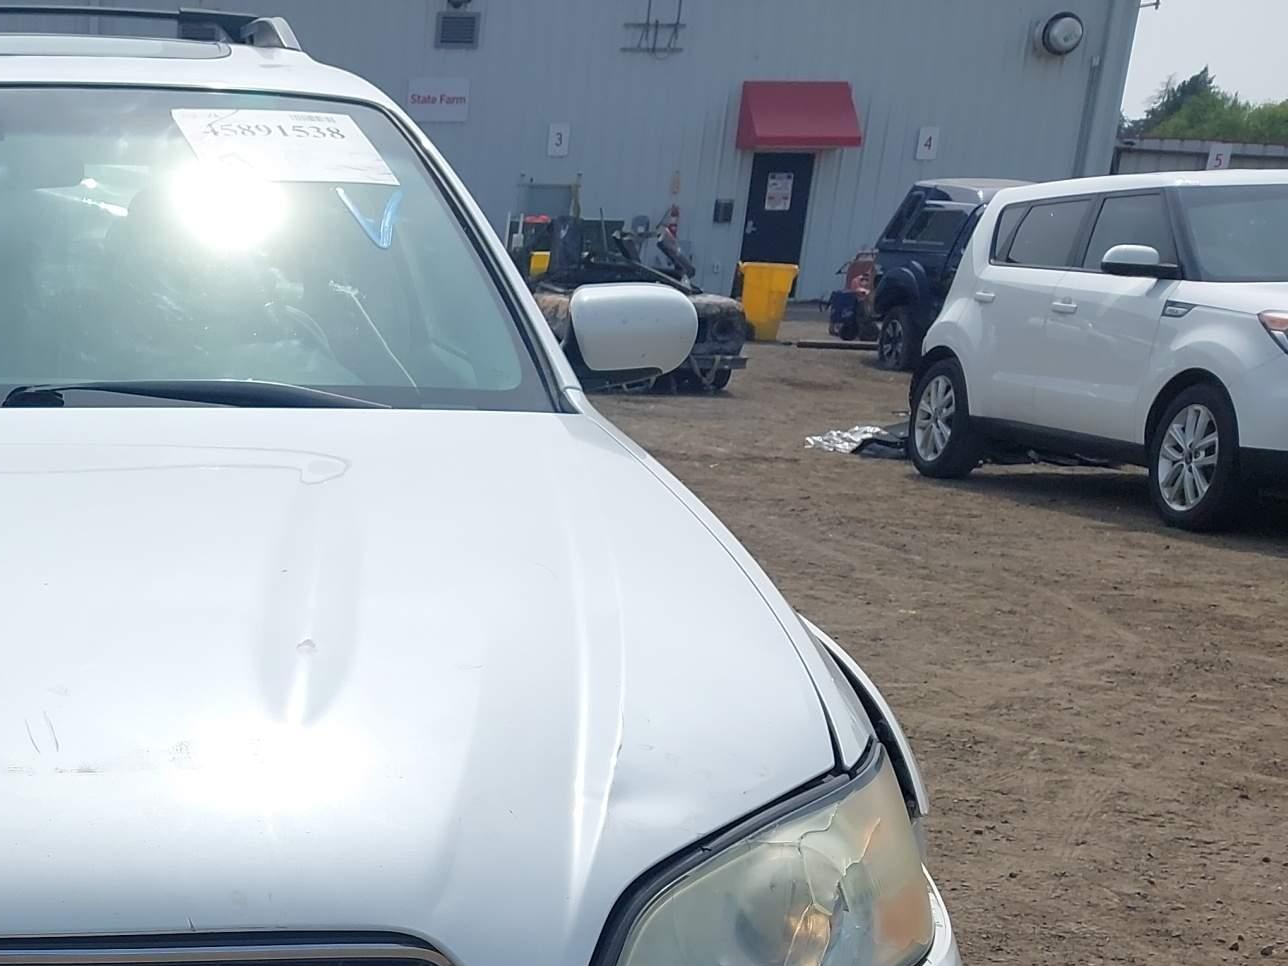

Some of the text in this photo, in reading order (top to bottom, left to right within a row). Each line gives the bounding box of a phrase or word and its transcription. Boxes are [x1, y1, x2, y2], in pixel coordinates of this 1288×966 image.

[410, 93, 467, 105] State Farm
[203, 123, 346, 140] 45891538
[555, 131, 563, 147] 3
[923, 135, 932, 150] 4
[1214, 153, 1224, 168] 5
